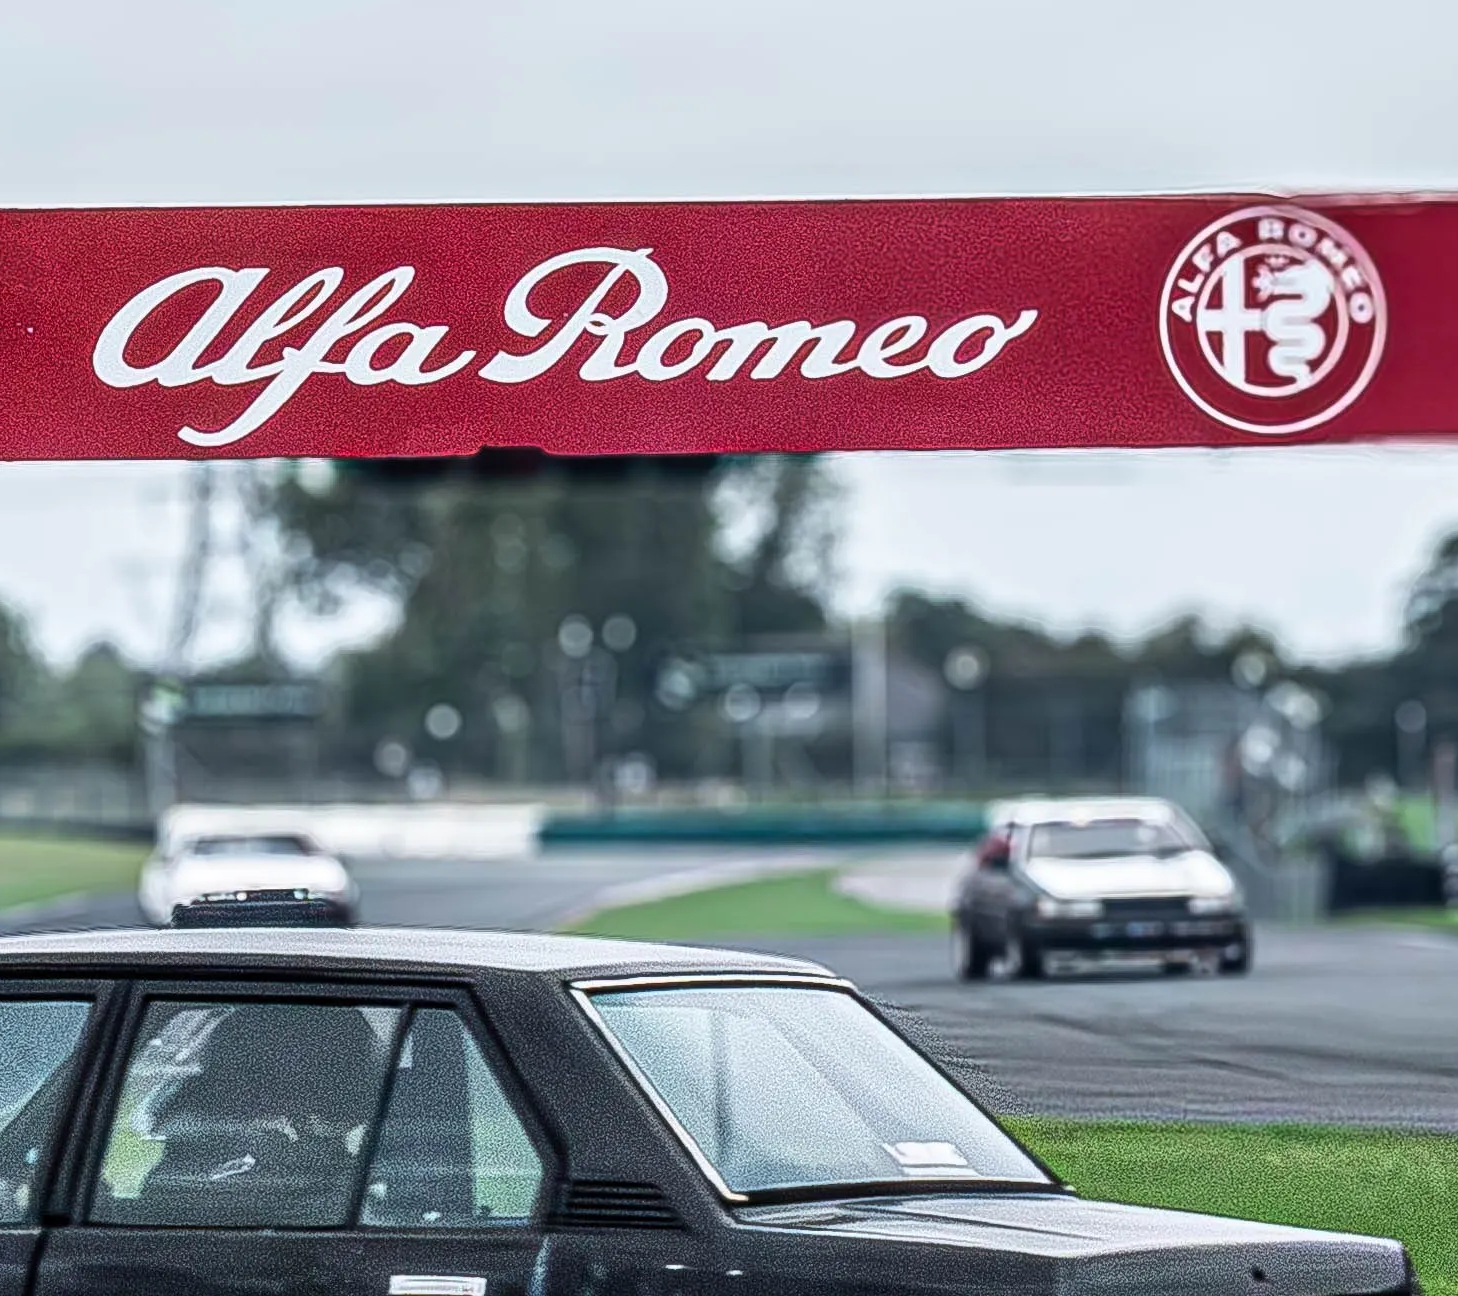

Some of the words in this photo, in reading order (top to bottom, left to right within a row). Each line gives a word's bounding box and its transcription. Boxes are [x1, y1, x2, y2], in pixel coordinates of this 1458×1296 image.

[92, 265, 482, 448] Alfa
[477, 246, 1038, 384] Romeo
[1171, 230, 1243, 323] ALFA
[1256, 216, 1375, 324] ROMEO
